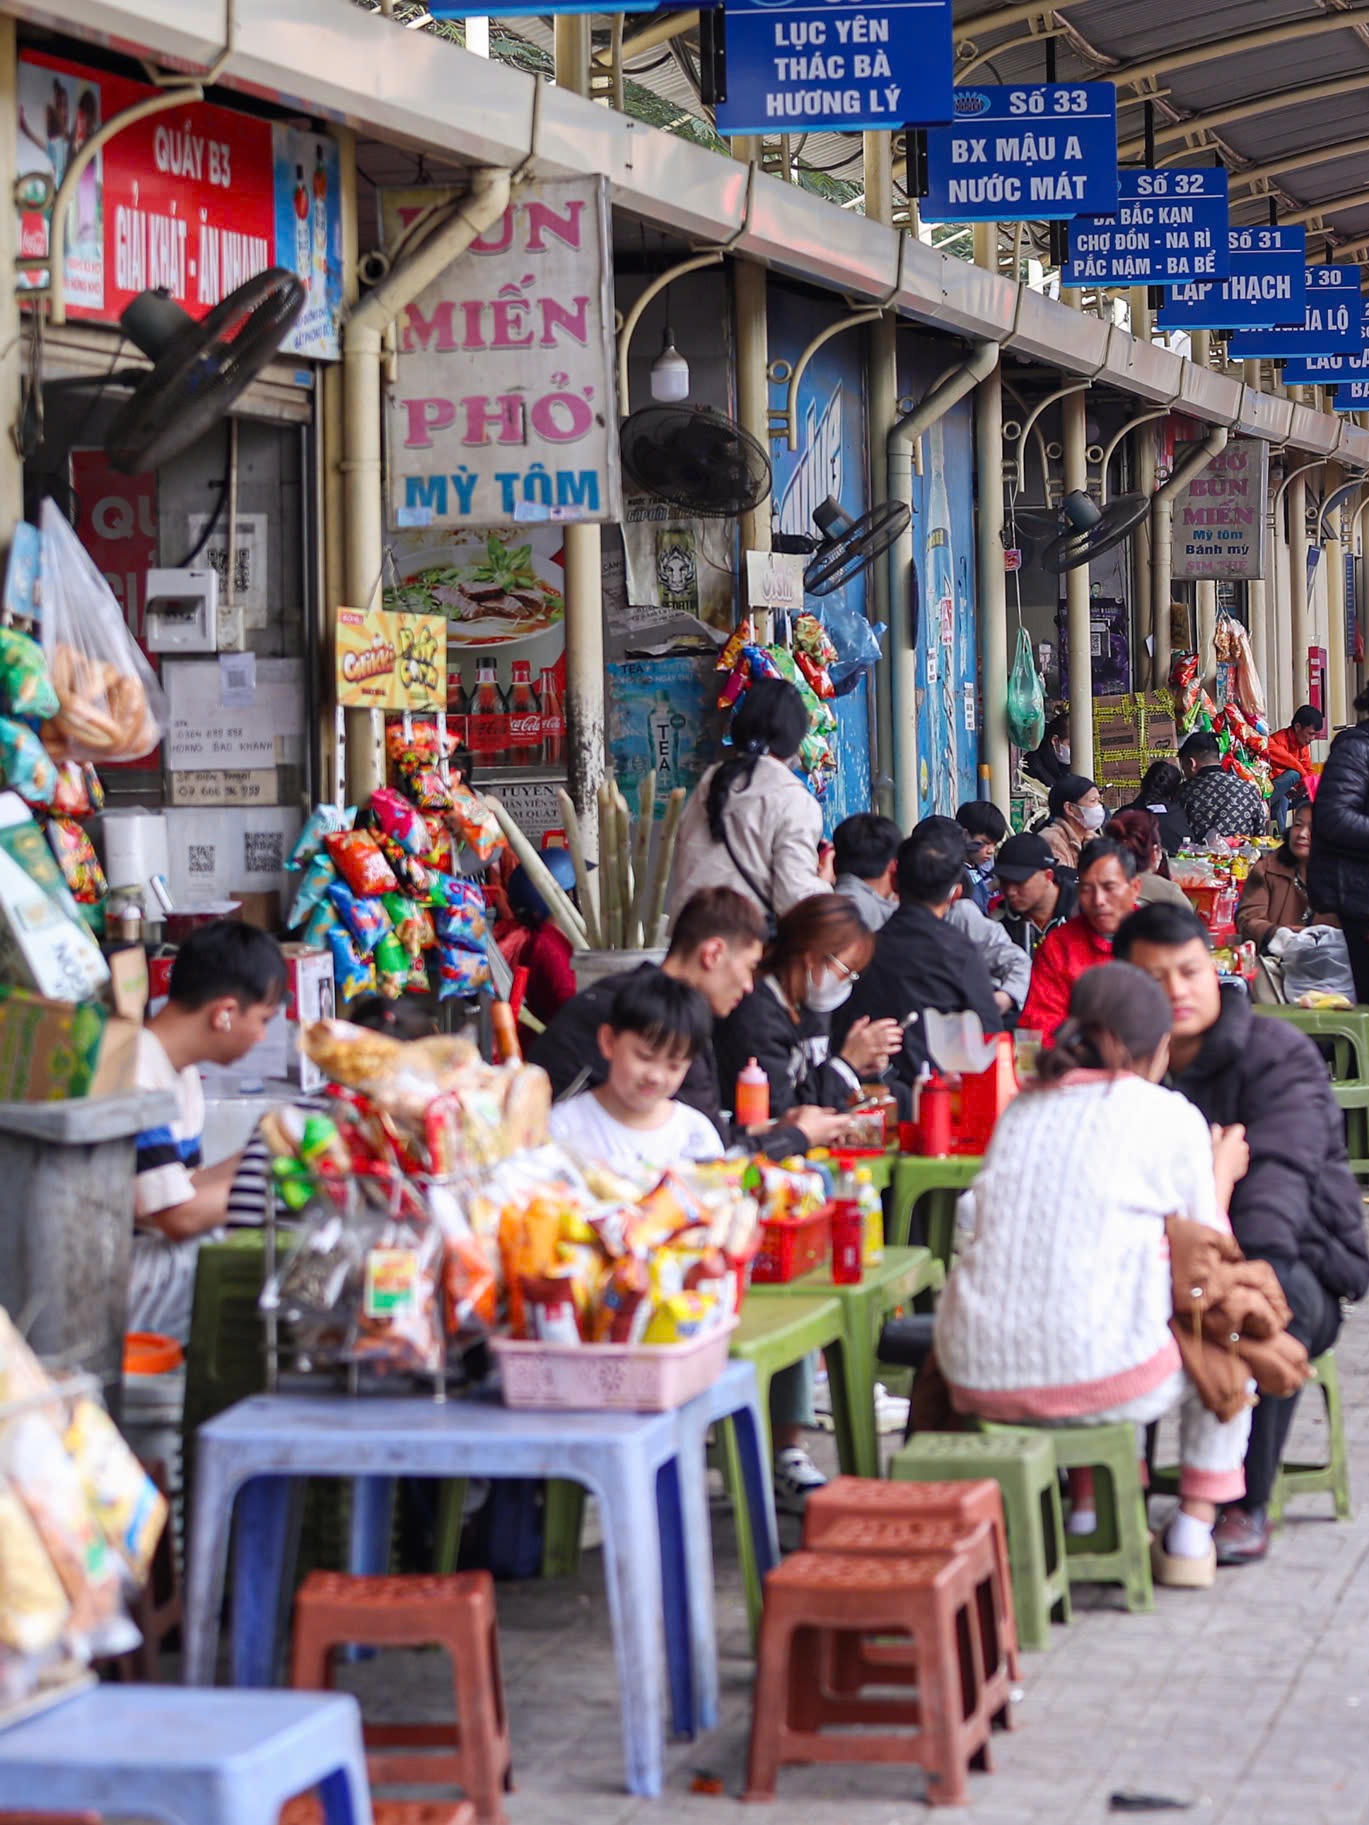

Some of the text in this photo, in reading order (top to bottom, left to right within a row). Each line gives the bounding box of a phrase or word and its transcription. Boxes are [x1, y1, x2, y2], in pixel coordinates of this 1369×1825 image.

[775, 15, 889, 50] LỤC YÊN
[774, 50, 891, 81] THÁC BÀ
[766, 84, 901, 117] HƯƠNG LÝ
[1054, 90, 1088, 112] 33
[209, 140, 231, 188] B3
[952, 133, 1083, 166] BX MẬU A
[949, 171, 1088, 203] NƯỚC MÁT
[1175, 174, 1204, 193] 32
[1121, 202, 1193, 227] BẮC KẠN
[1077, 233, 1110, 254] CHỢ
[1166, 231, 1190, 248] NA
[1194, 228, 1211, 248] RÌ
[1258, 231, 1281, 248] 31
[1074, 254, 1107, 277] PẮC
[1167, 257, 1190, 274] BA
[1194, 250, 1216, 273] BỂ
[1319, 270, 1342, 285] 30
[1328, 305, 1349, 335] LỘ
[401, 371, 594, 448] PHỞ
[405, 463, 600, 516] MỲ TÔM
[1186, 544, 1222, 555] Bánh
